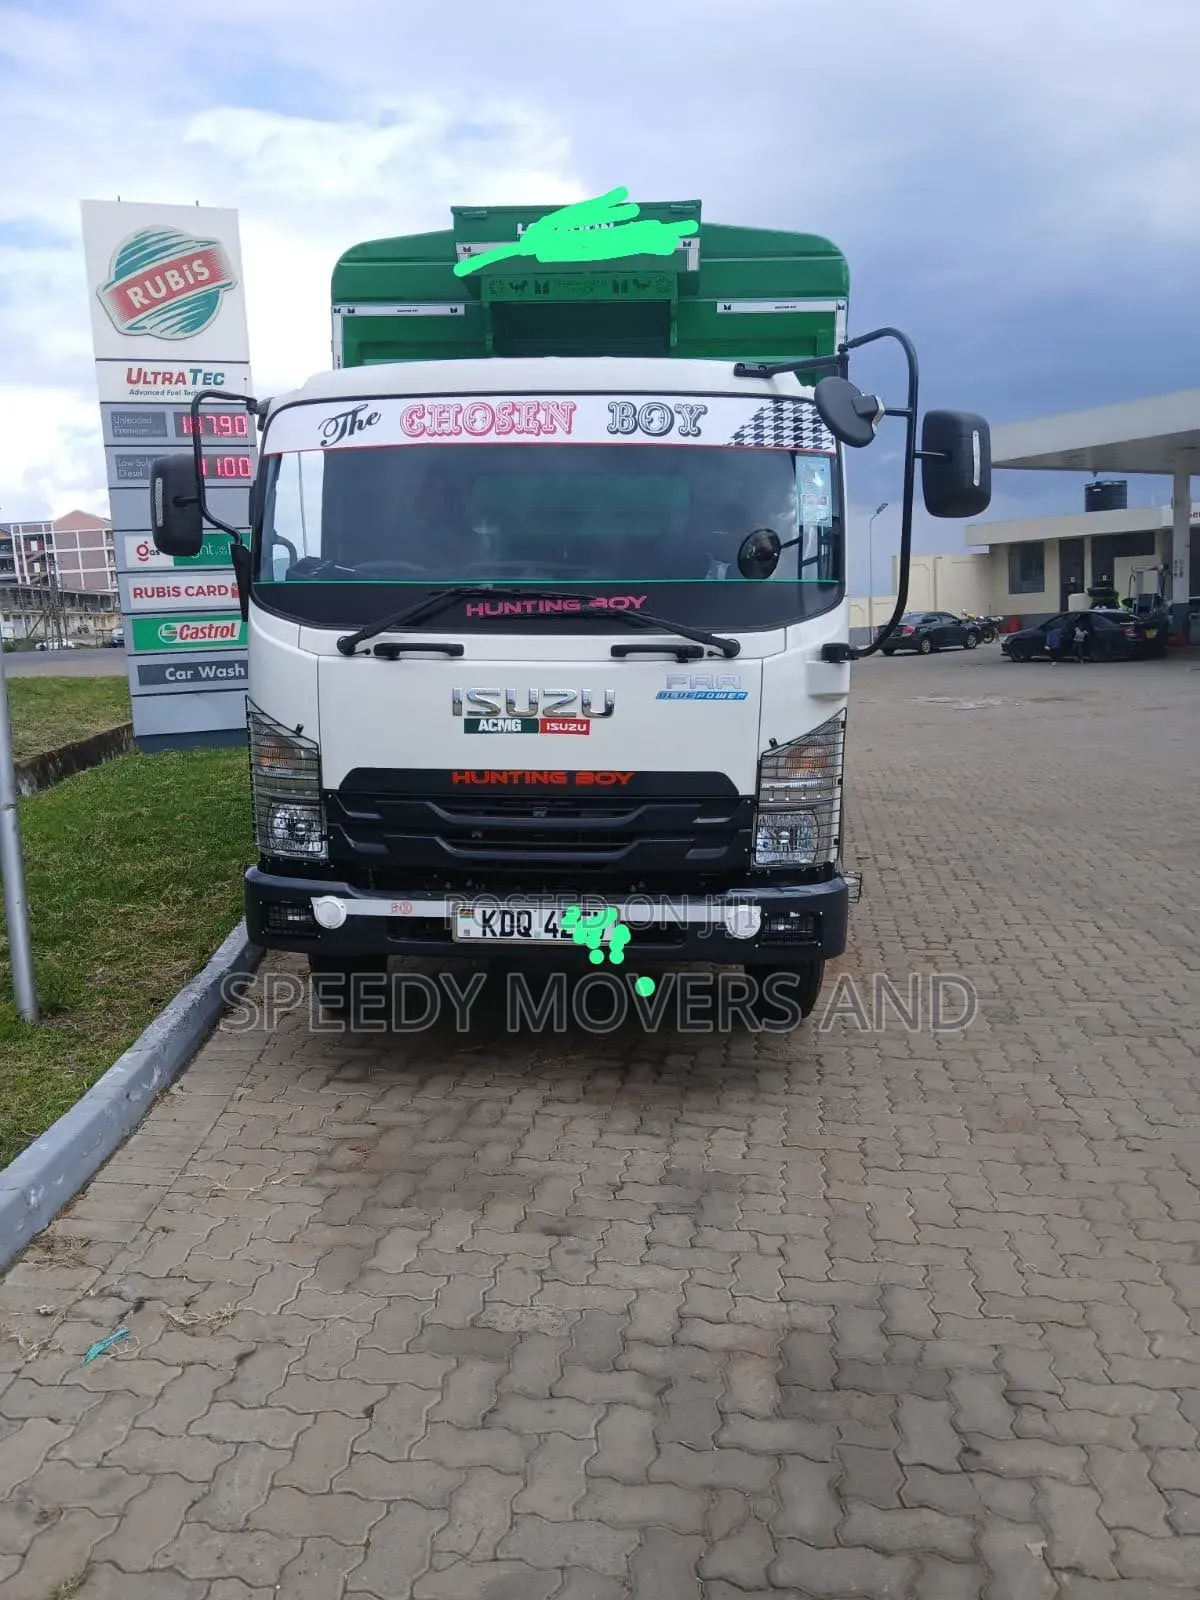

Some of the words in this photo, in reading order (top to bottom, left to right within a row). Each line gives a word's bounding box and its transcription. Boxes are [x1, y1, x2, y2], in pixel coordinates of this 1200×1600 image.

[128, 389, 165, 397] Advanced
[112, 415, 152, 424] Unleaded
[319, 404, 381, 447] The
[400, 401, 577, 437] CHOSEN
[607, 401, 708, 438] BOY
[118, 469, 143, 478] Diesel
[184, 584, 229, 598] CARD
[466, 598, 582, 617] HUNTING
[588, 594, 648, 611] BOY
[179, 622, 236, 641] Castrol
[165, 667, 194, 681] Car
[198, 663, 246, 679] Wash
[451, 687, 617, 718] ISUZU
[477, 718, 522, 733] ACMG
[545, 722, 588, 733] ISUZU
[452, 771, 568, 786] HUNTING
[575, 771, 636, 786] BOY
[482, 909, 532, 938] KDQ
